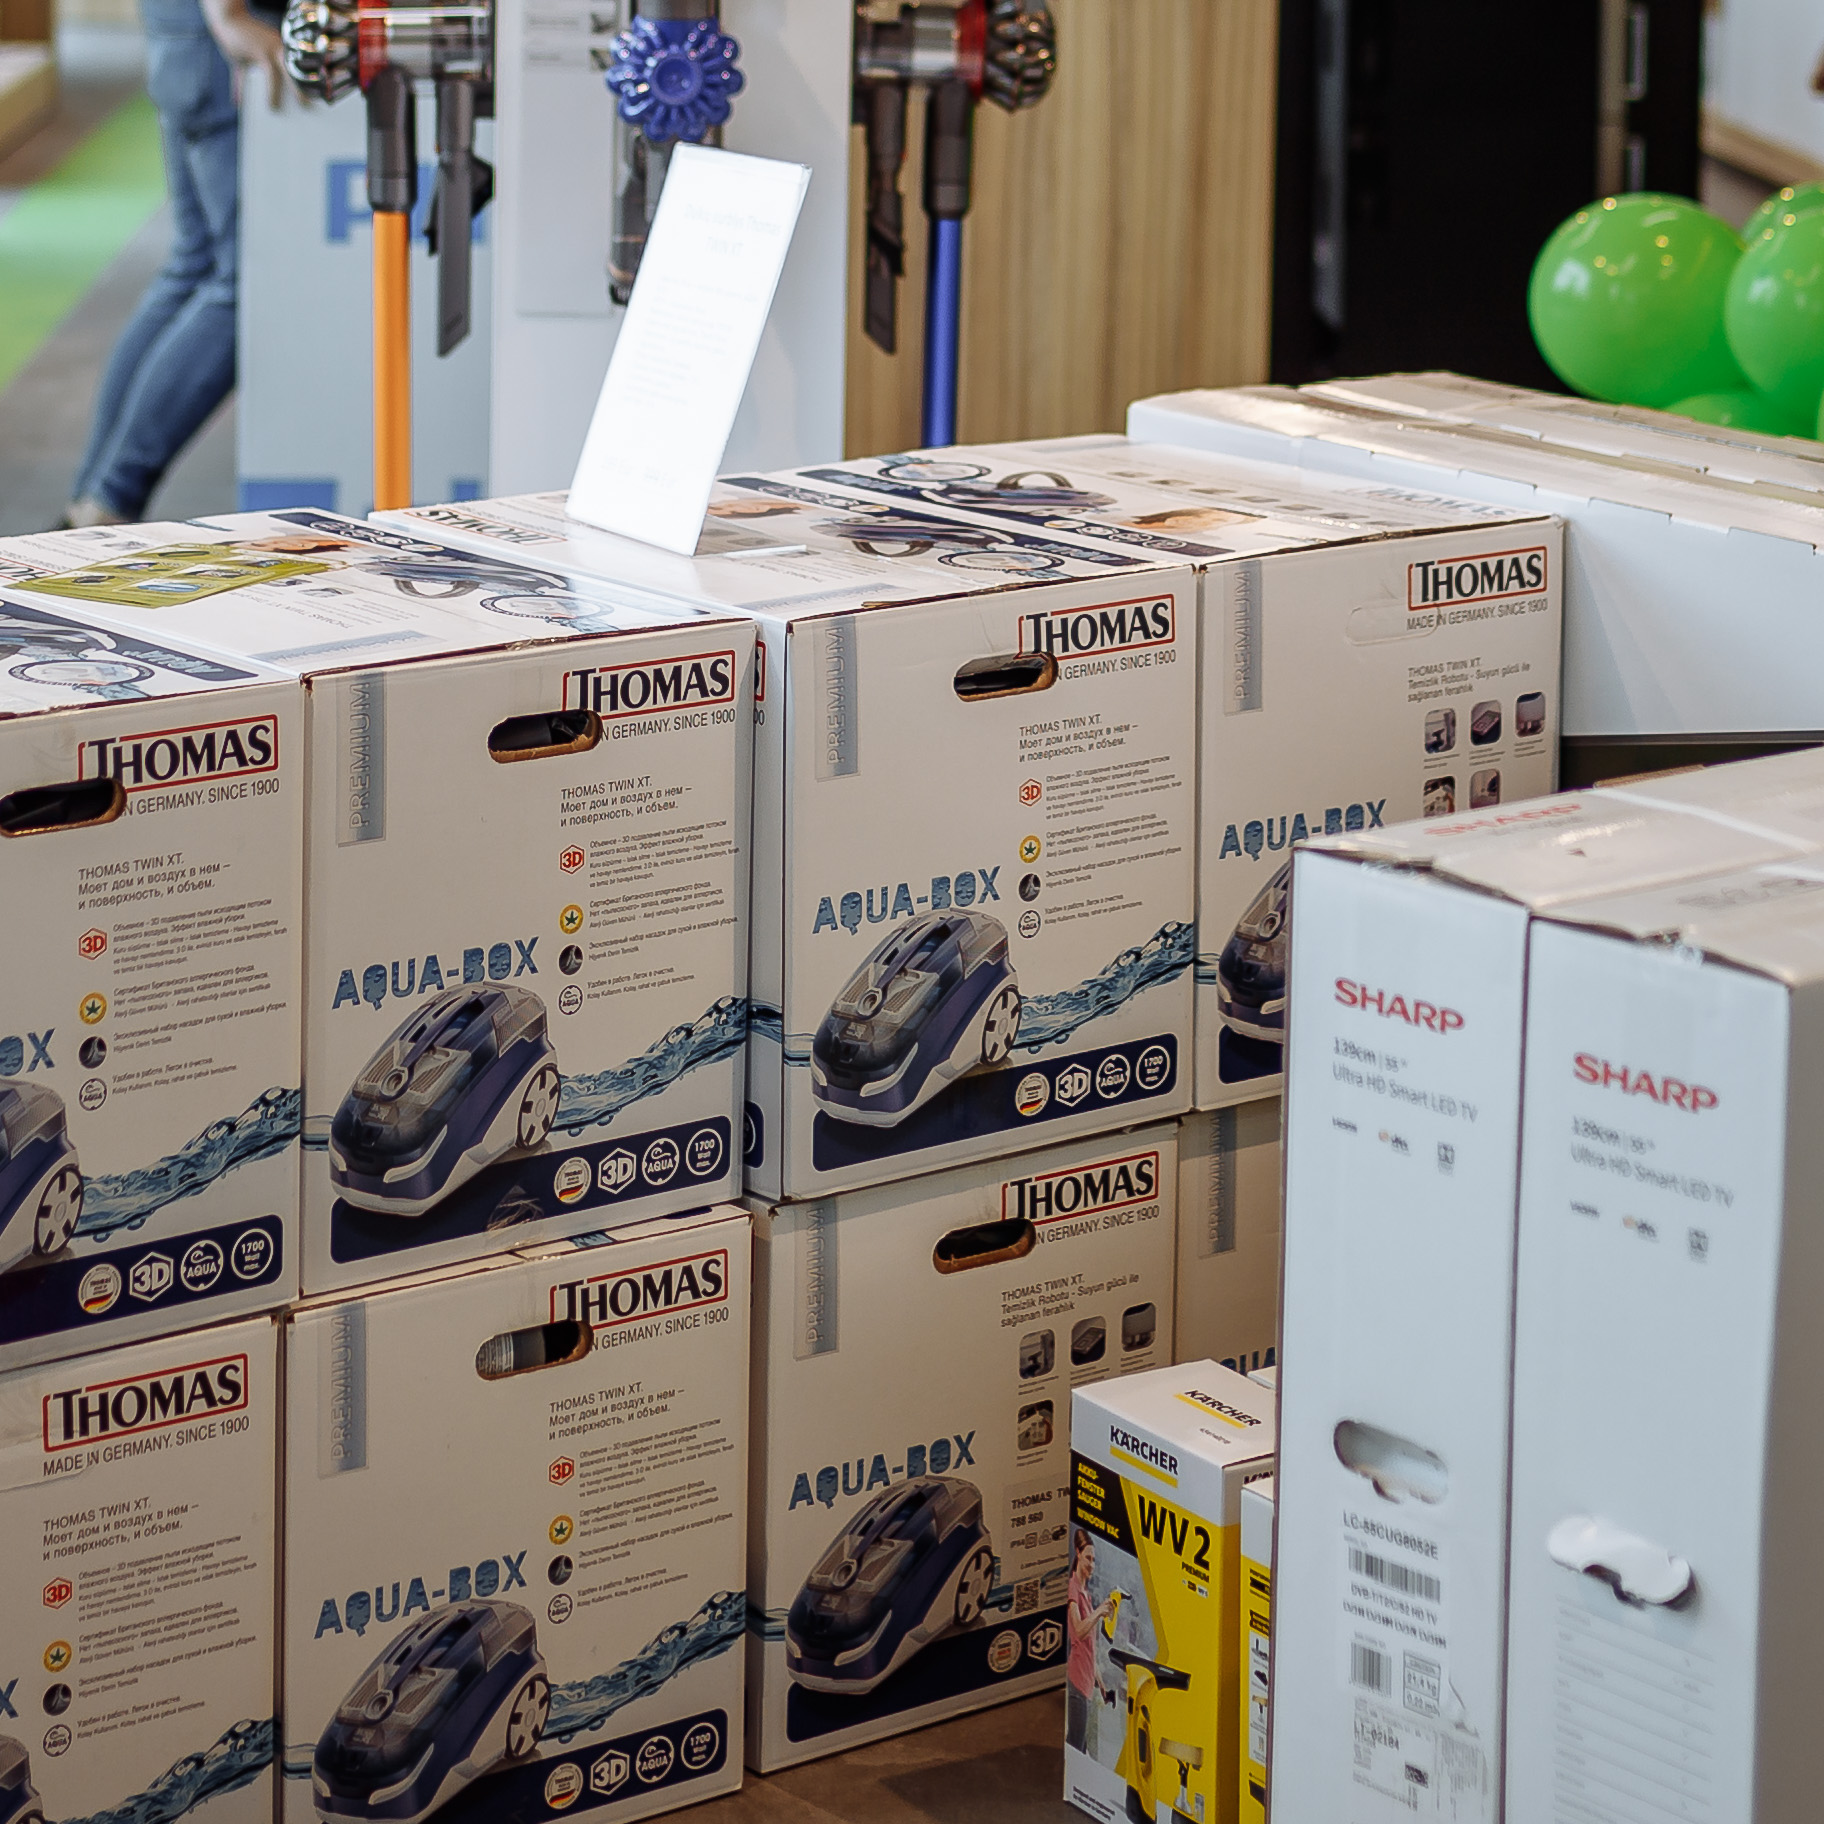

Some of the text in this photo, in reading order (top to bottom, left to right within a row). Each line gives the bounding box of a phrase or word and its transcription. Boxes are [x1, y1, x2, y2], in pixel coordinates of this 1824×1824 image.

[1415, 553, 1542, 603] THOMAS
[1025, 602, 1170, 655] THOMAS
[1407, 616, 1434, 631] MADE
[1497, 603, 1526, 617] SINCE
[571, 658, 730, 712] THOMAS
[1408, 663, 1445, 677] THOMAS
[1446, 660, 1468, 672] TWIN
[826, 626, 846, 766] PREMIUM
[673, 713, 709, 732] SINCE
[710, 707, 736, 725] 1900
[88, 724, 272, 785] THOMAS
[350, 680, 371, 830] PREMIUM
[137, 778, 279, 815] GERMANY. SINCE 1900
[561, 783, 605, 800] THOMAS
[608, 778, 634, 793] TWIN
[561, 800, 586, 813] Моет
[589, 798, 608, 810] дом
[611, 796, 617, 805] и
[620, 792, 653, 805] воздух
[561, 818, 566, 827] и
[637, 806, 642, 815] и
[1218, 799, 1387, 861] AQUA-BOX
[78, 861, 130, 881] THOMAS
[133, 855, 163, 872] TWIN
[563, 851, 582, 868] 3D
[812, 865, 1001, 935] AQUA-BOX
[82, 936, 105, 953] 3D
[332, 936, 540, 1010] AQUA-BOX
[1333, 977, 1465, 1035] SHARP
[1366, 1074, 1387, 1095] HD
[1389, 1079, 1429, 1110] Smart
[1432, 1091, 1457, 1118] LED
[1461, 1104, 1478, 1123] TV
[1573, 1052, 1719, 1113] SHARP
[648, 1159, 673, 1174] AQUA
[694, 1139, 715, 1152] 1700
[601, 1158, 632, 1185] 3D
[1010, 1160, 1153, 1219] THOMAS
[241, 1240, 264, 1254] 1700
[134, 1263, 170, 1292] 3D
[187, 1262, 217, 1279] AQUA
[558, 1257, 723, 1323] THOMAS
[53, 1363, 242, 1442] THOMAS
[331, 1314, 352, 1462] PREMIUM
[1184, 1390, 1262, 1427] KÄRCHER
[43, 1455, 84, 1477] MADE
[175, 1424, 217, 1448] SINCE
[220, 1415, 250, 1437] 1900
[1110, 1425, 1179, 1475] KÄRCHER
[788, 1430, 977, 1509] AQUA-BOX
[43, 1509, 95, 1532] THOMAS
[99, 1502, 130, 1519] TWIN
[1011, 1491, 1052, 1510] THOMAS
[1194, 1526, 1211, 1570] 2
[314, 1549, 528, 1639] AQUA-BOX
